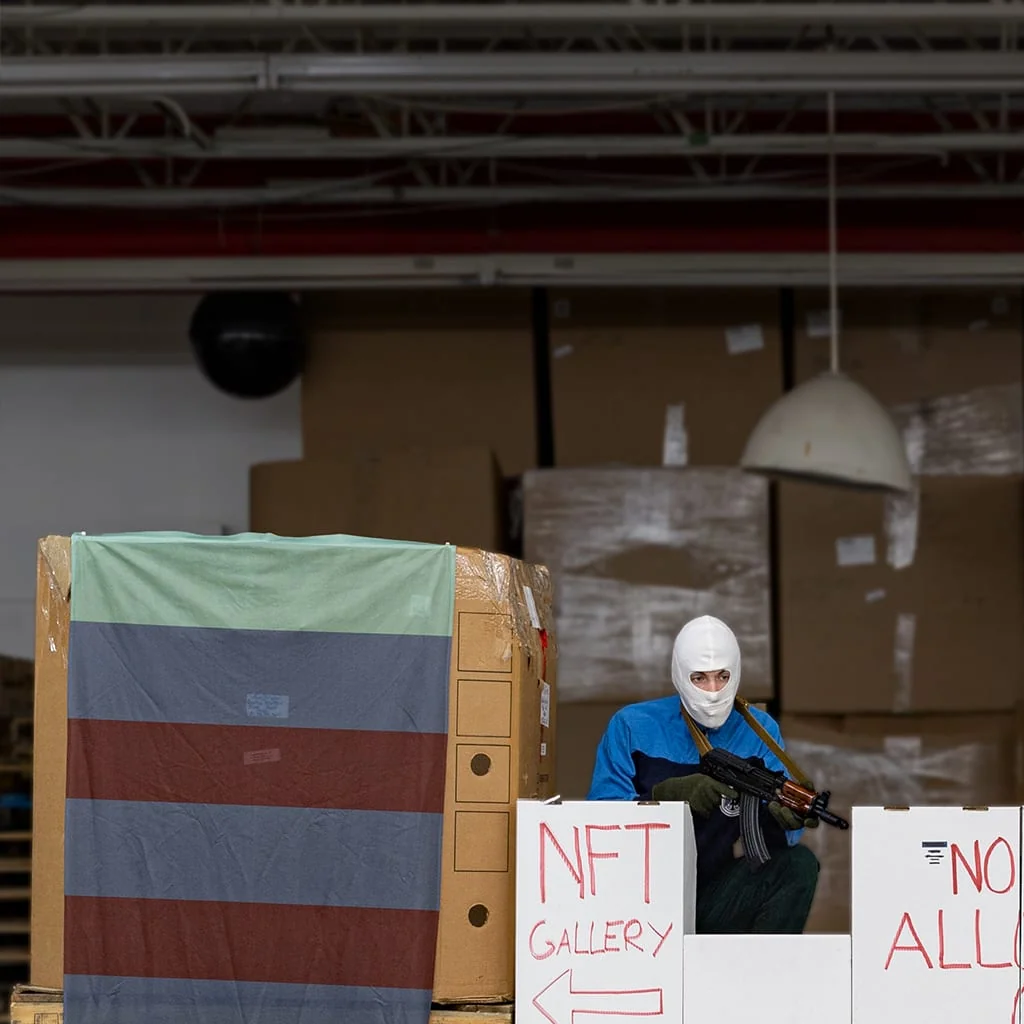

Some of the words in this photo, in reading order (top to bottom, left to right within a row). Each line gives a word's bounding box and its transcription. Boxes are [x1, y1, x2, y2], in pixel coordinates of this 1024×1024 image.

[540, 822, 671, 904] NFT
[951, 836, 1016, 895] NO
[529, 918, 673, 961] GALLERY
